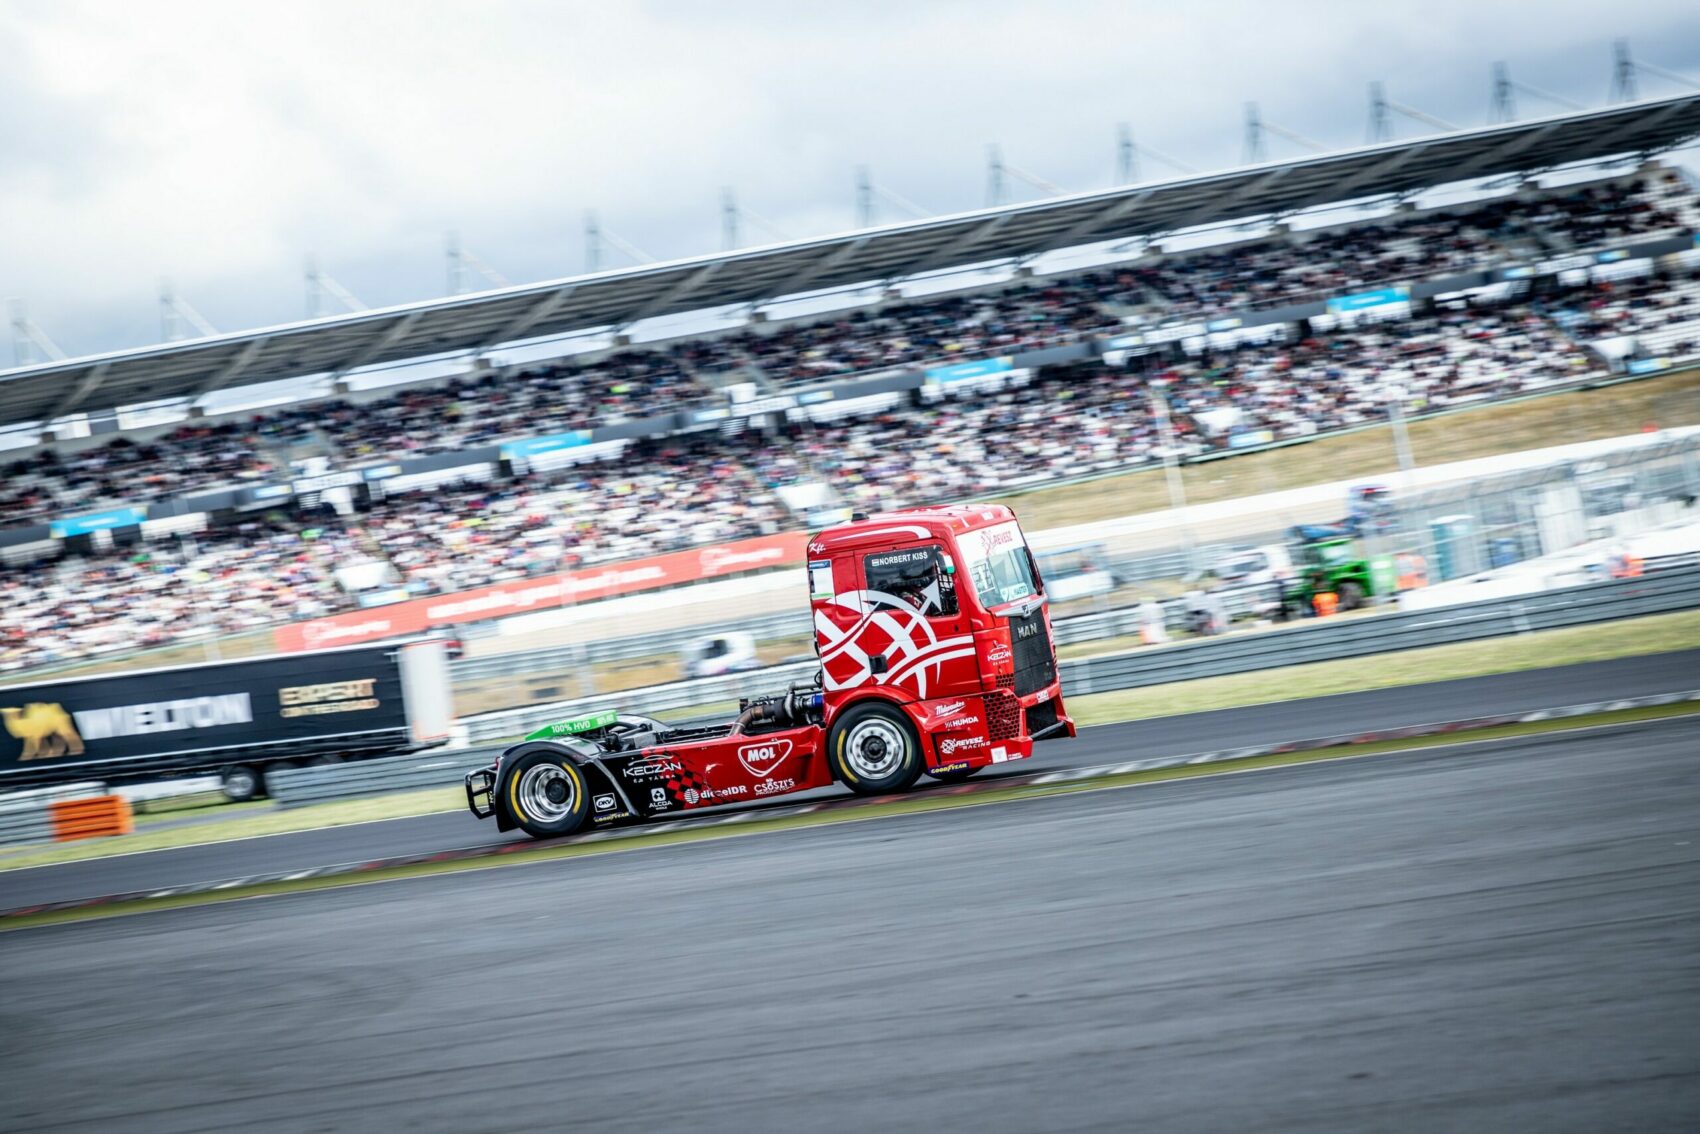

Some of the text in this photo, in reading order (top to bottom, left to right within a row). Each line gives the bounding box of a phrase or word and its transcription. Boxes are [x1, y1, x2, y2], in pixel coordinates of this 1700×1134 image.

[879, 551, 928, 565] NORBERT KISS
[1017, 622, 1038, 639] MAN
[551, 720, 591, 733] 100% HVO
[952, 716, 979, 727] HUMDA
[747, 747, 776, 762] MOL
[931, 763, 967, 774] GOODYEAR
[701, 785, 747, 799] dielDR
[648, 800, 673, 809] ALCOA
